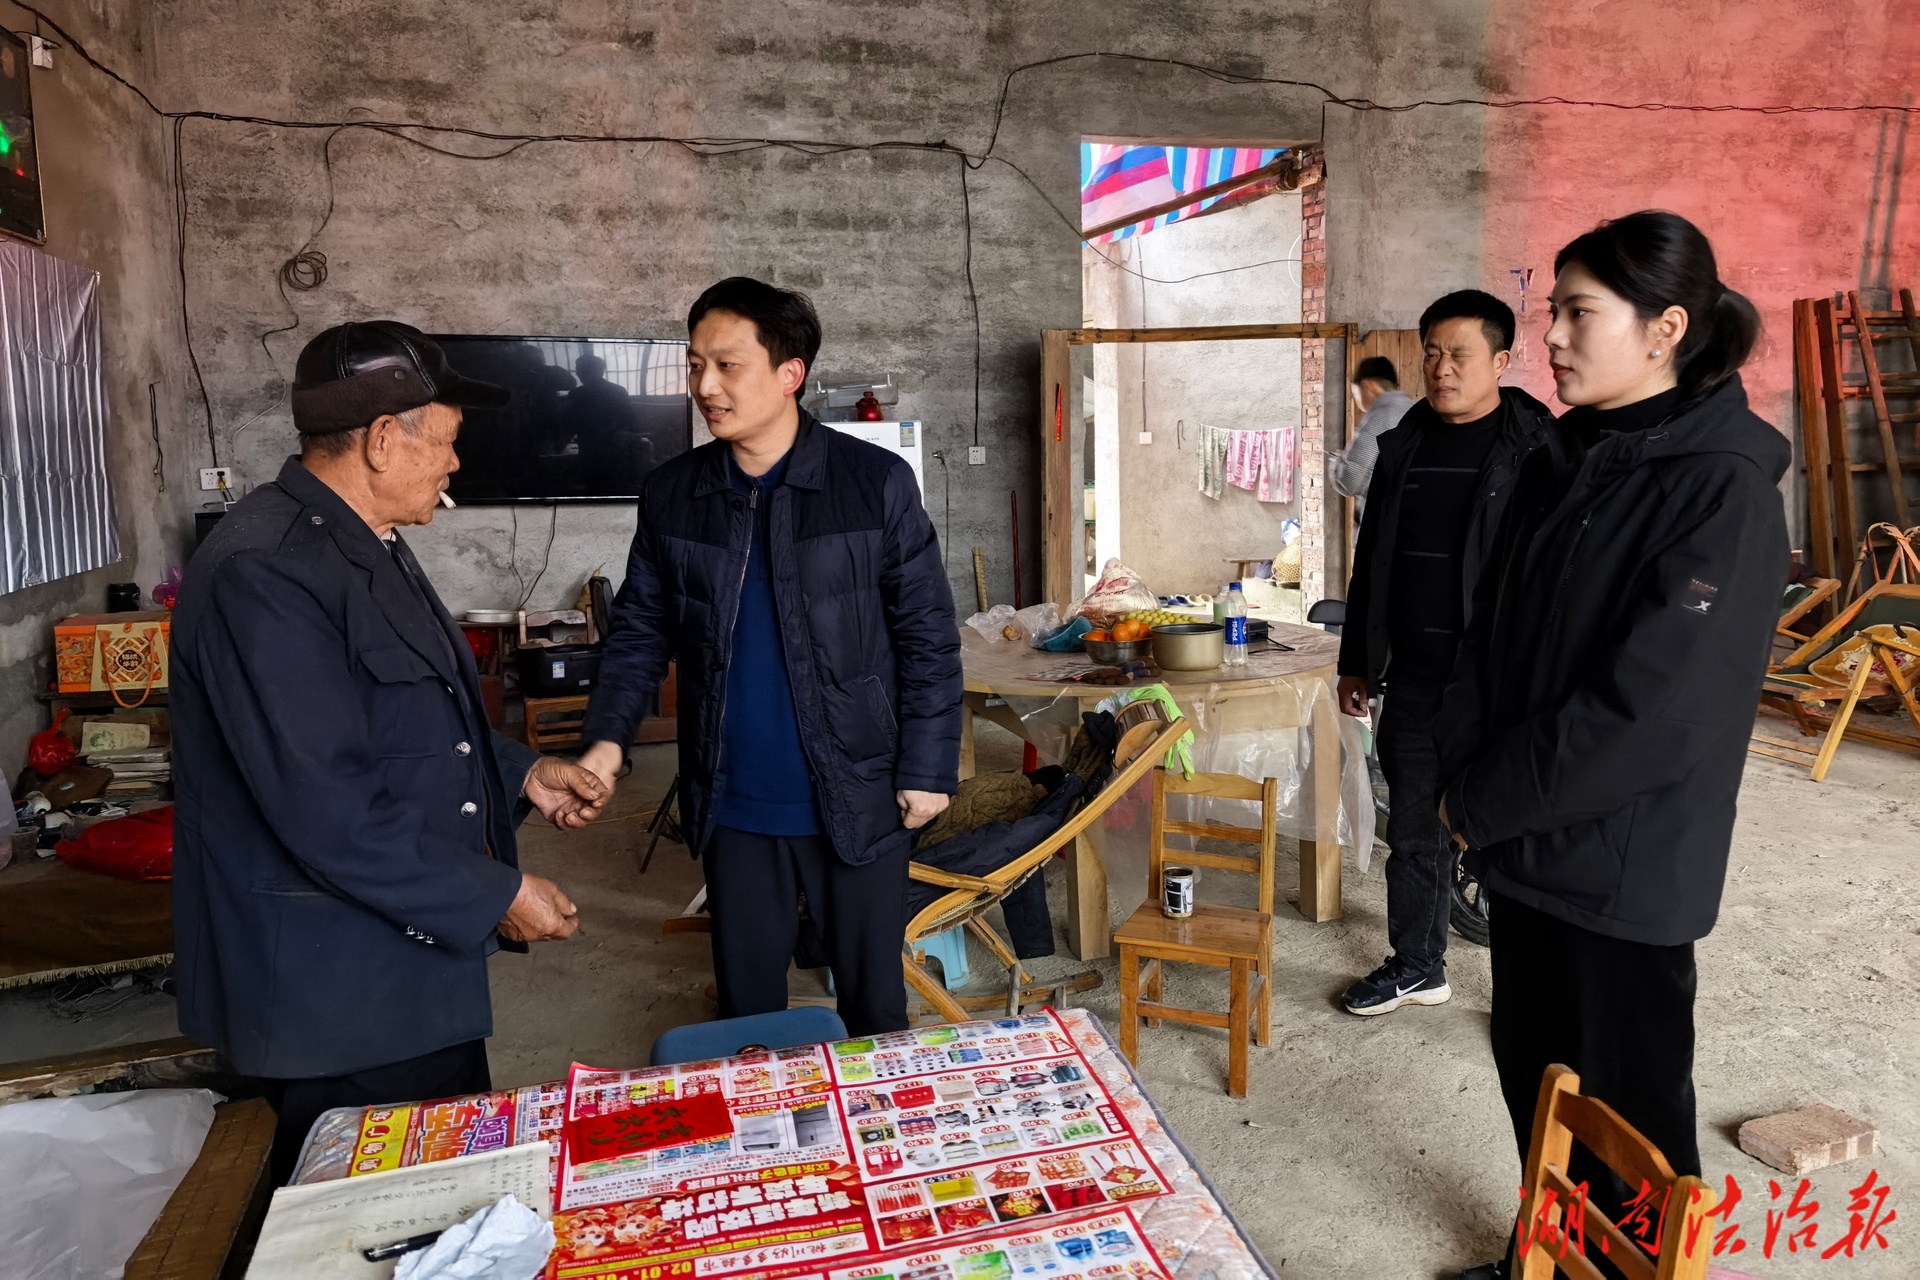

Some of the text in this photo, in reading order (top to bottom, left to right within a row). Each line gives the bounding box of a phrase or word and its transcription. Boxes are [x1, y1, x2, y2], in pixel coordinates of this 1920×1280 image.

[357, 1111, 392, 1171] 购物广场
[468, 1115, 508, 1157] 值购
[944, 1132, 965, 1141] 2.90
[907, 1138, 928, 1147] 4.90
[892, 1181, 913, 1190] 1.20
[660, 1176, 828, 1220] 年货不打烊
[1012, 1188, 1034, 1198] 1.90
[957, 1199, 980, 1209] 29.9
[685, 1191, 850, 1240] 新年狂欢购
